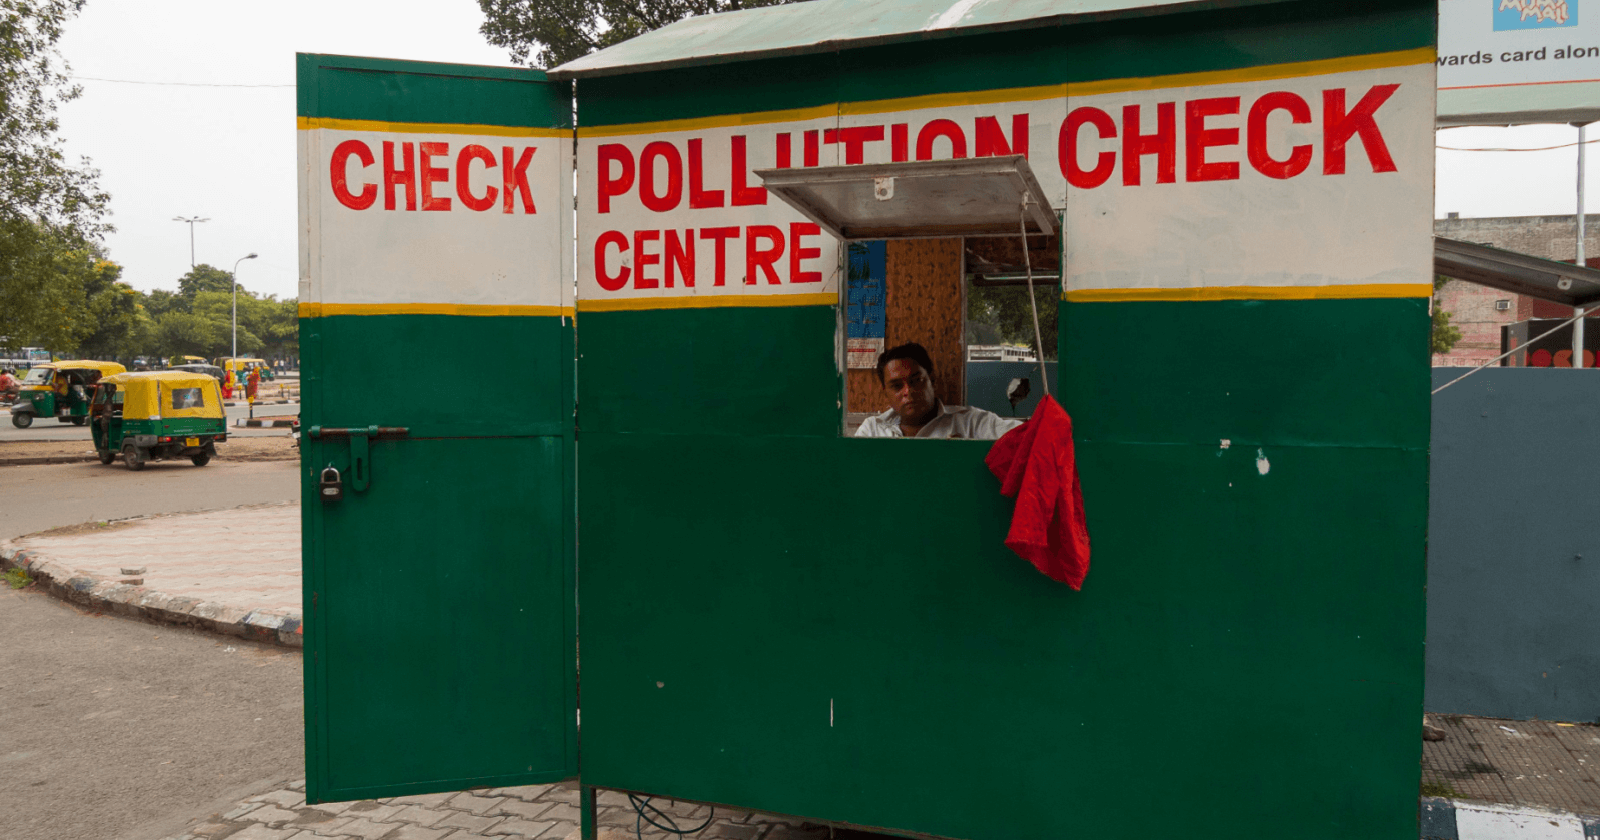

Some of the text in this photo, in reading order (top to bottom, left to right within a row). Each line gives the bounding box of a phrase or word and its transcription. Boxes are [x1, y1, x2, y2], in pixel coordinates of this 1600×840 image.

[1500, 46, 1547, 63] card
[1058, 83, 1402, 190] CHECK
[330, 139, 538, 215] CHECK
[594, 222, 823, 291] CENTRE
